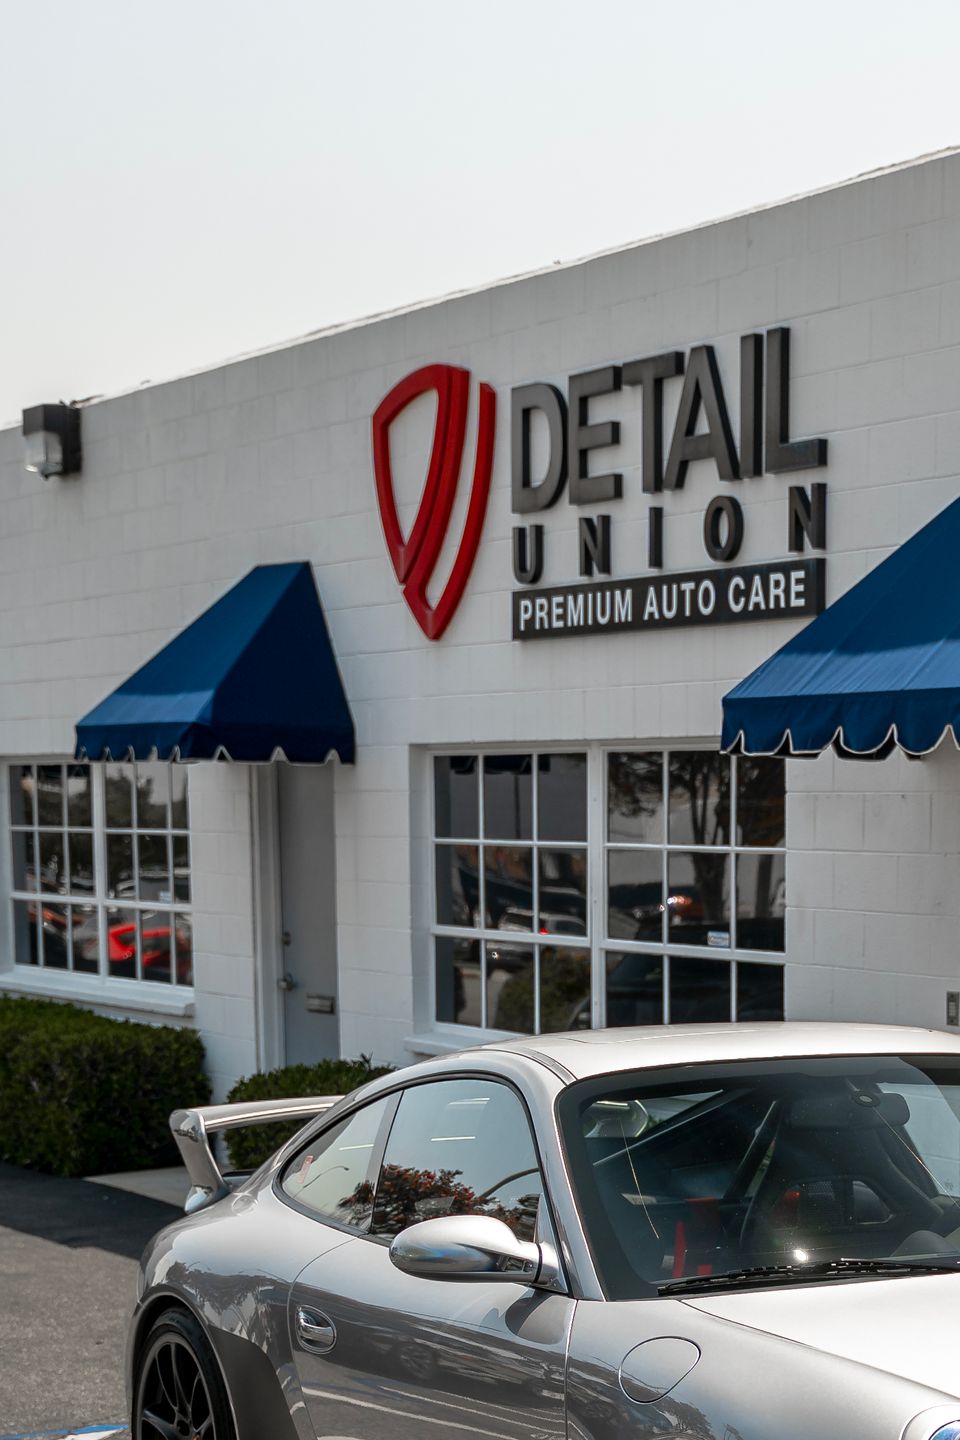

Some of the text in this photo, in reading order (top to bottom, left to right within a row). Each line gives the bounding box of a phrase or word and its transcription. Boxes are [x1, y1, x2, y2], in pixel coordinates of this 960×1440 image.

[511, 327, 827, 513] DETAIL
[512, 482, 827, 585] UNION
[518, 570, 806, 631] PREMIUM AUTO CARE
